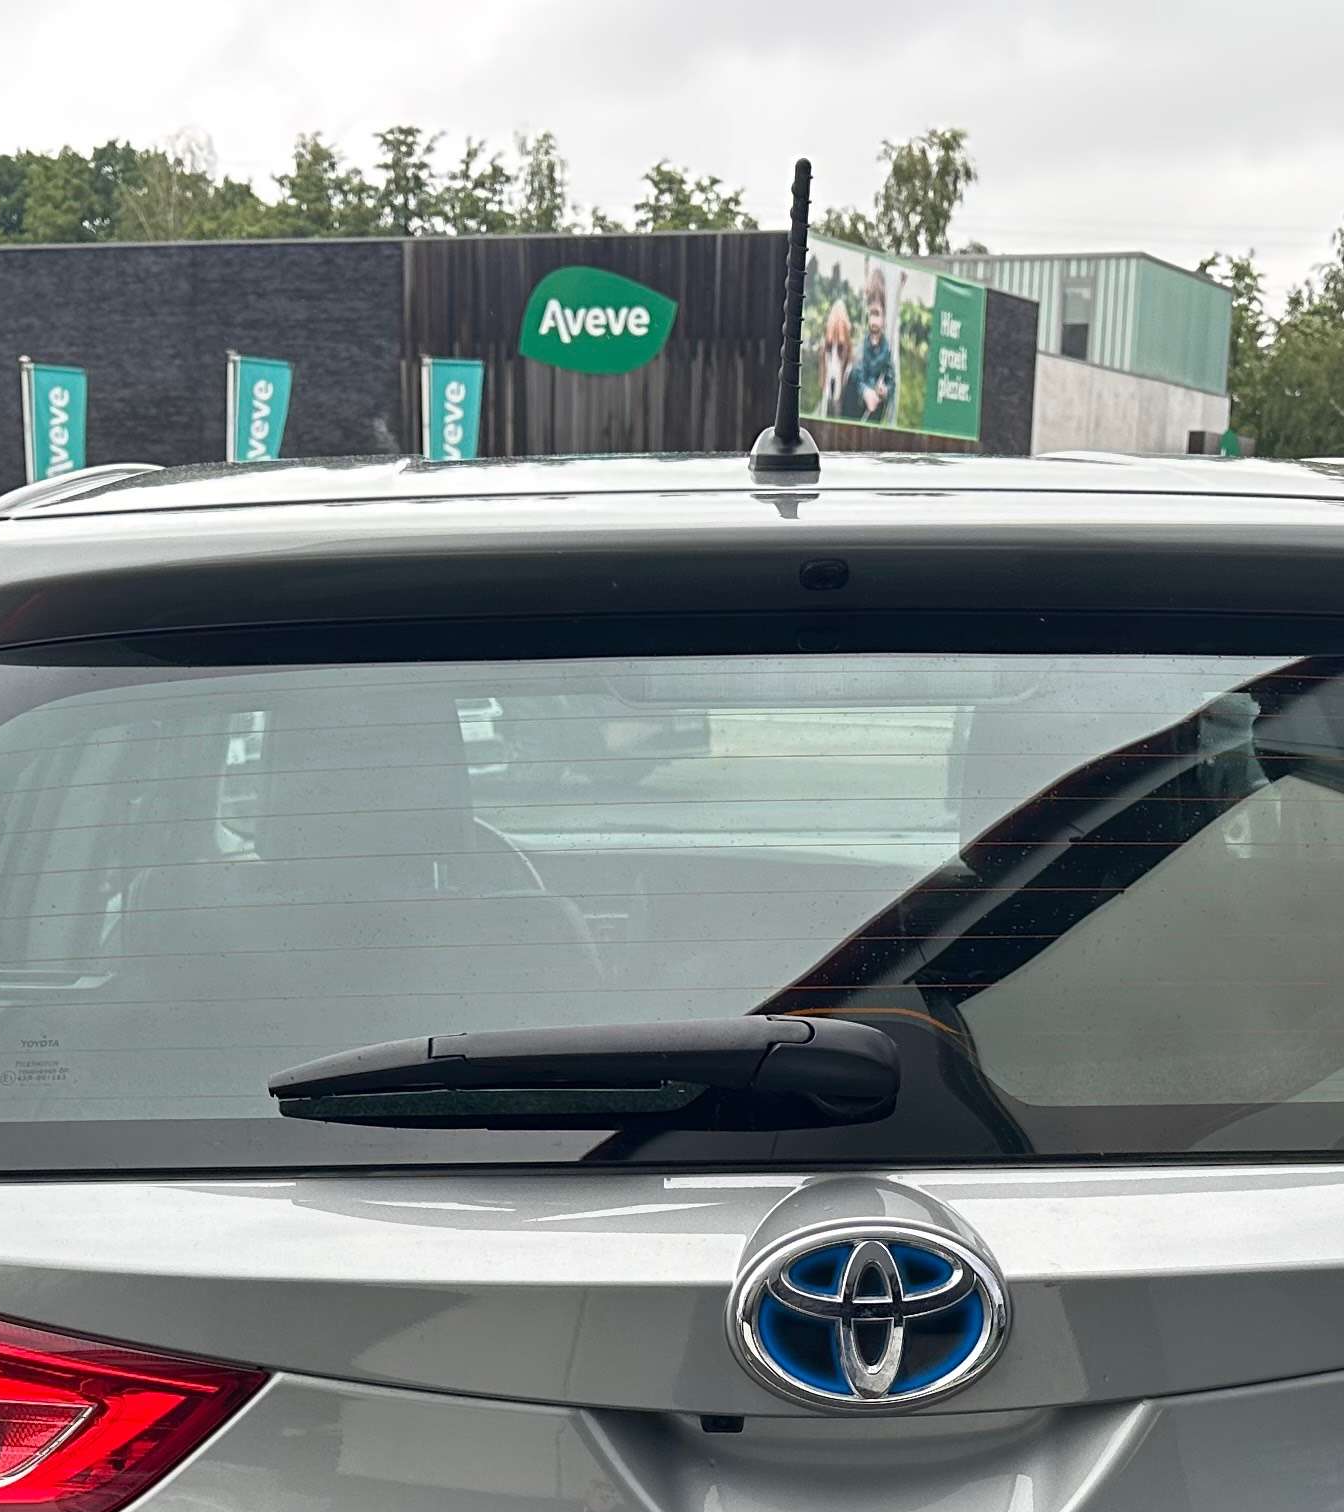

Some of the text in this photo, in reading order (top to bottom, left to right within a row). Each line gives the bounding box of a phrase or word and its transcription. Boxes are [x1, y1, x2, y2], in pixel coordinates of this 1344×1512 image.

[539, 298, 651, 344] Aveve
[245, 379, 274, 460] veve
[443, 380, 466, 460] veve
